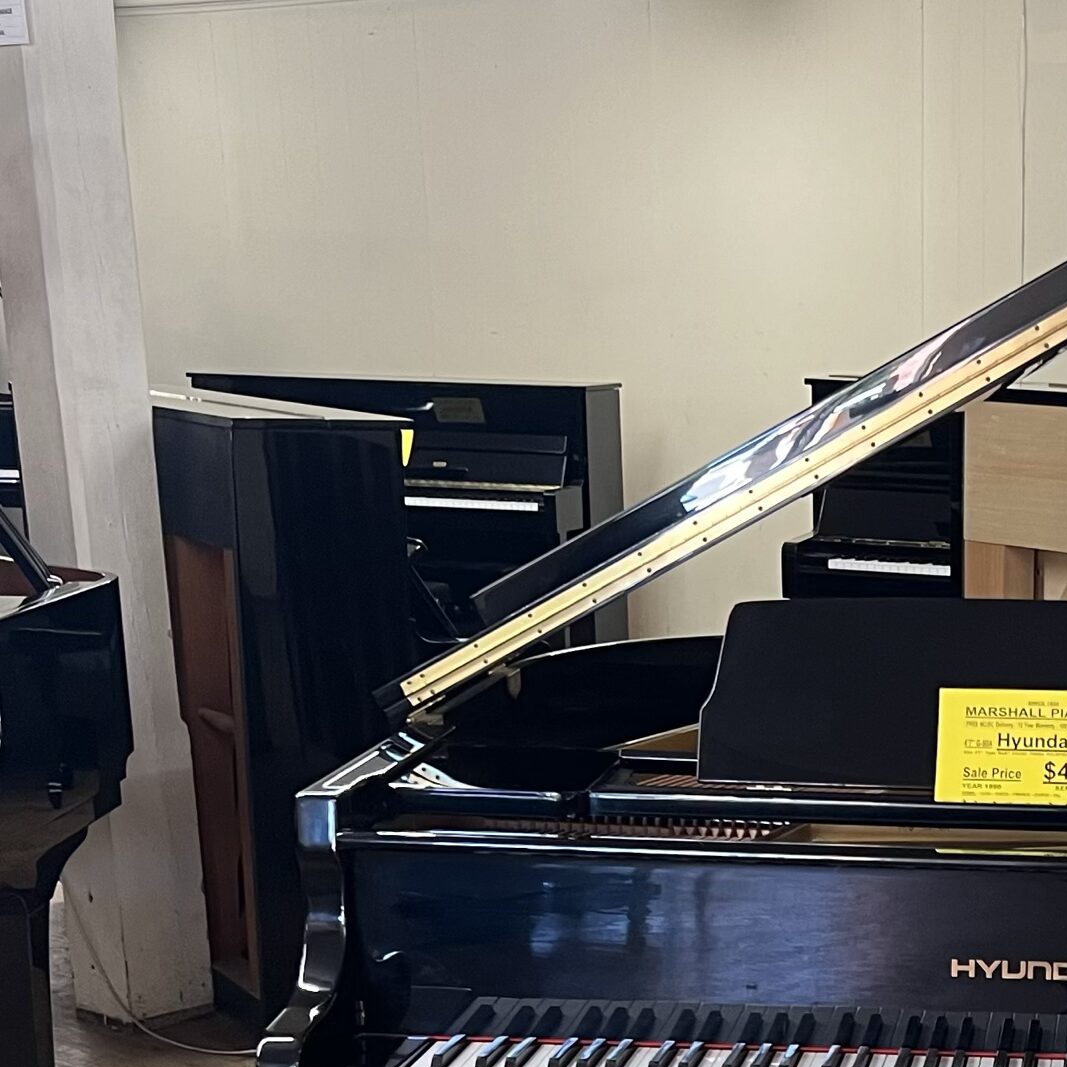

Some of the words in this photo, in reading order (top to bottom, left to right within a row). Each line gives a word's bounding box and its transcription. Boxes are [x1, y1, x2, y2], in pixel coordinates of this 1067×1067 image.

[965, 706, 1046, 719] MARSHALL
[963, 767, 990, 779] Sale
[992, 768, 1022, 780] Price
